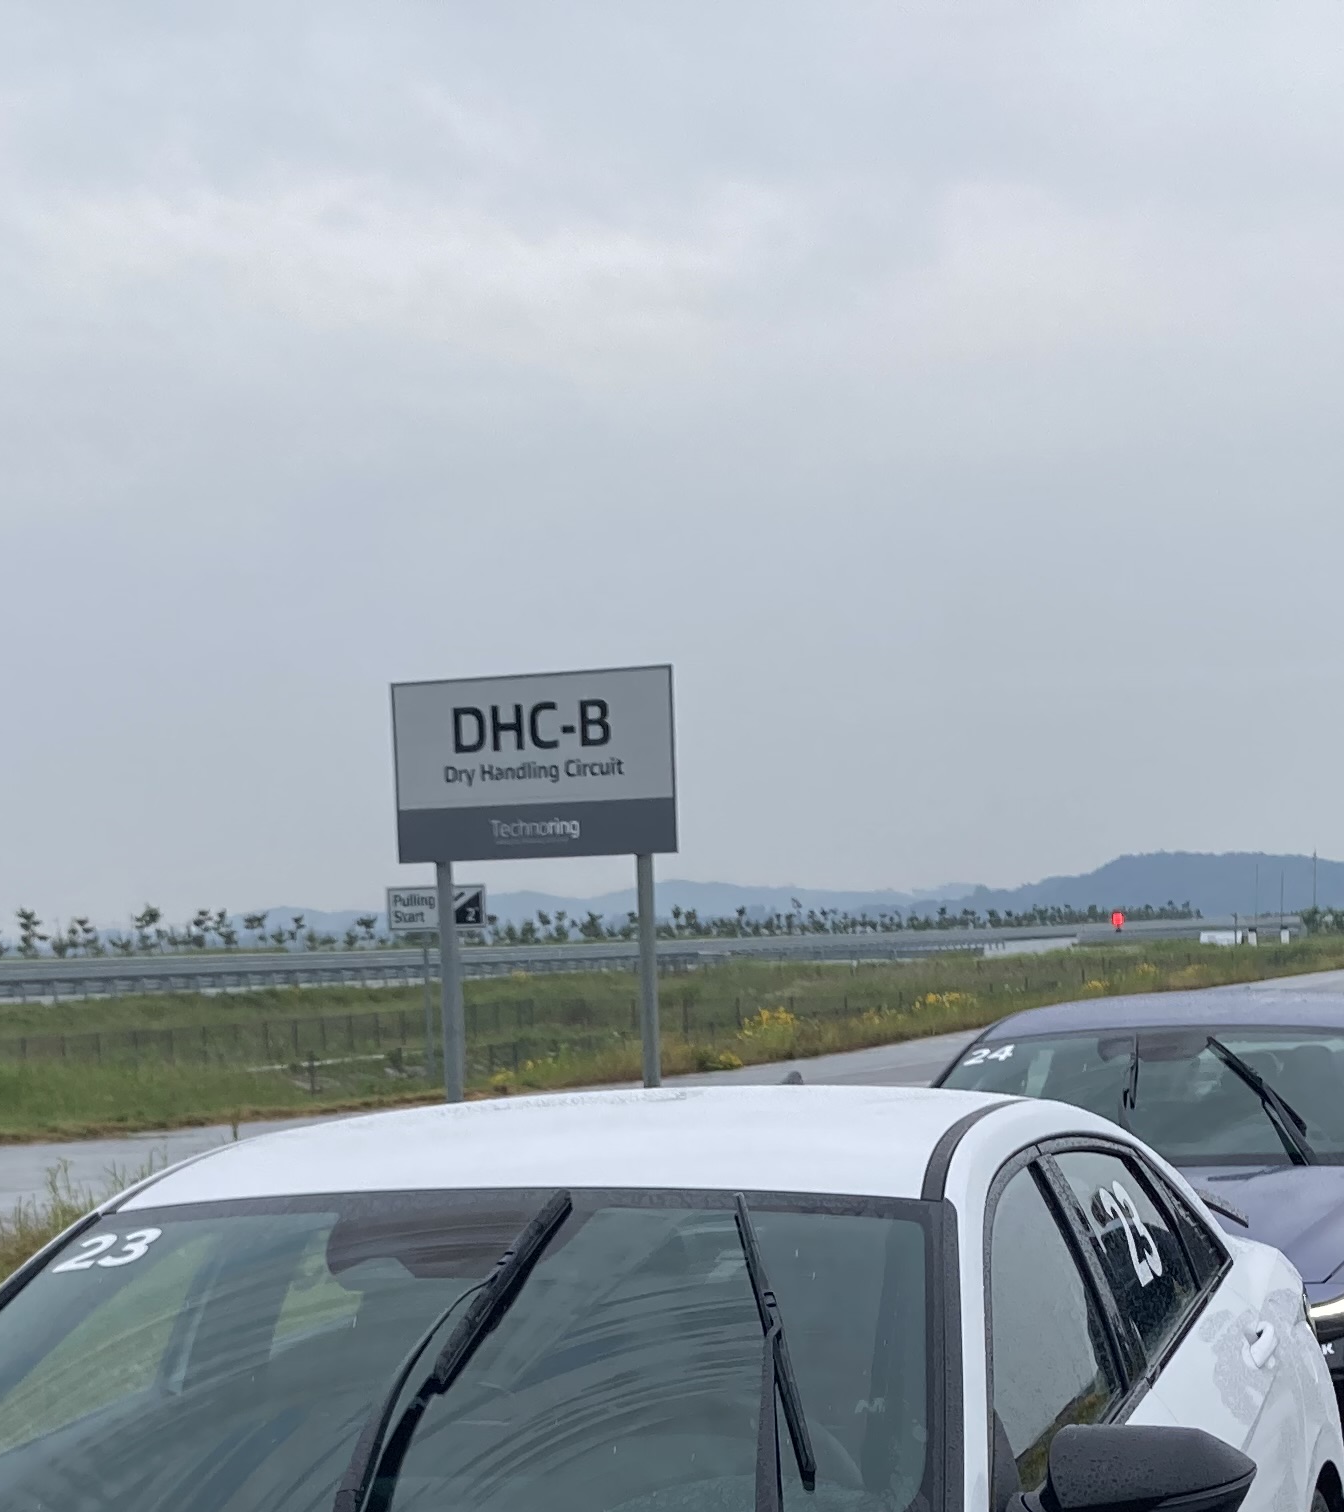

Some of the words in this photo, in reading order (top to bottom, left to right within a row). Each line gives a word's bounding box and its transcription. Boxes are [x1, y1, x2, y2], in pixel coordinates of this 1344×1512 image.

[452, 699, 611, 753] DHC-B
[444, 766, 475, 787] Dry
[480, 761, 560, 783] Handling
[564, 757, 625, 777] Circuit
[490, 817, 580, 838] Technoring
[393, 894, 436, 909] Pulling
[393, 911, 425, 923] Start
[963, 1044, 1015, 1066] 24
[1099, 1180, 1163, 1287] 23
[52, 1227, 162, 1273] 23
